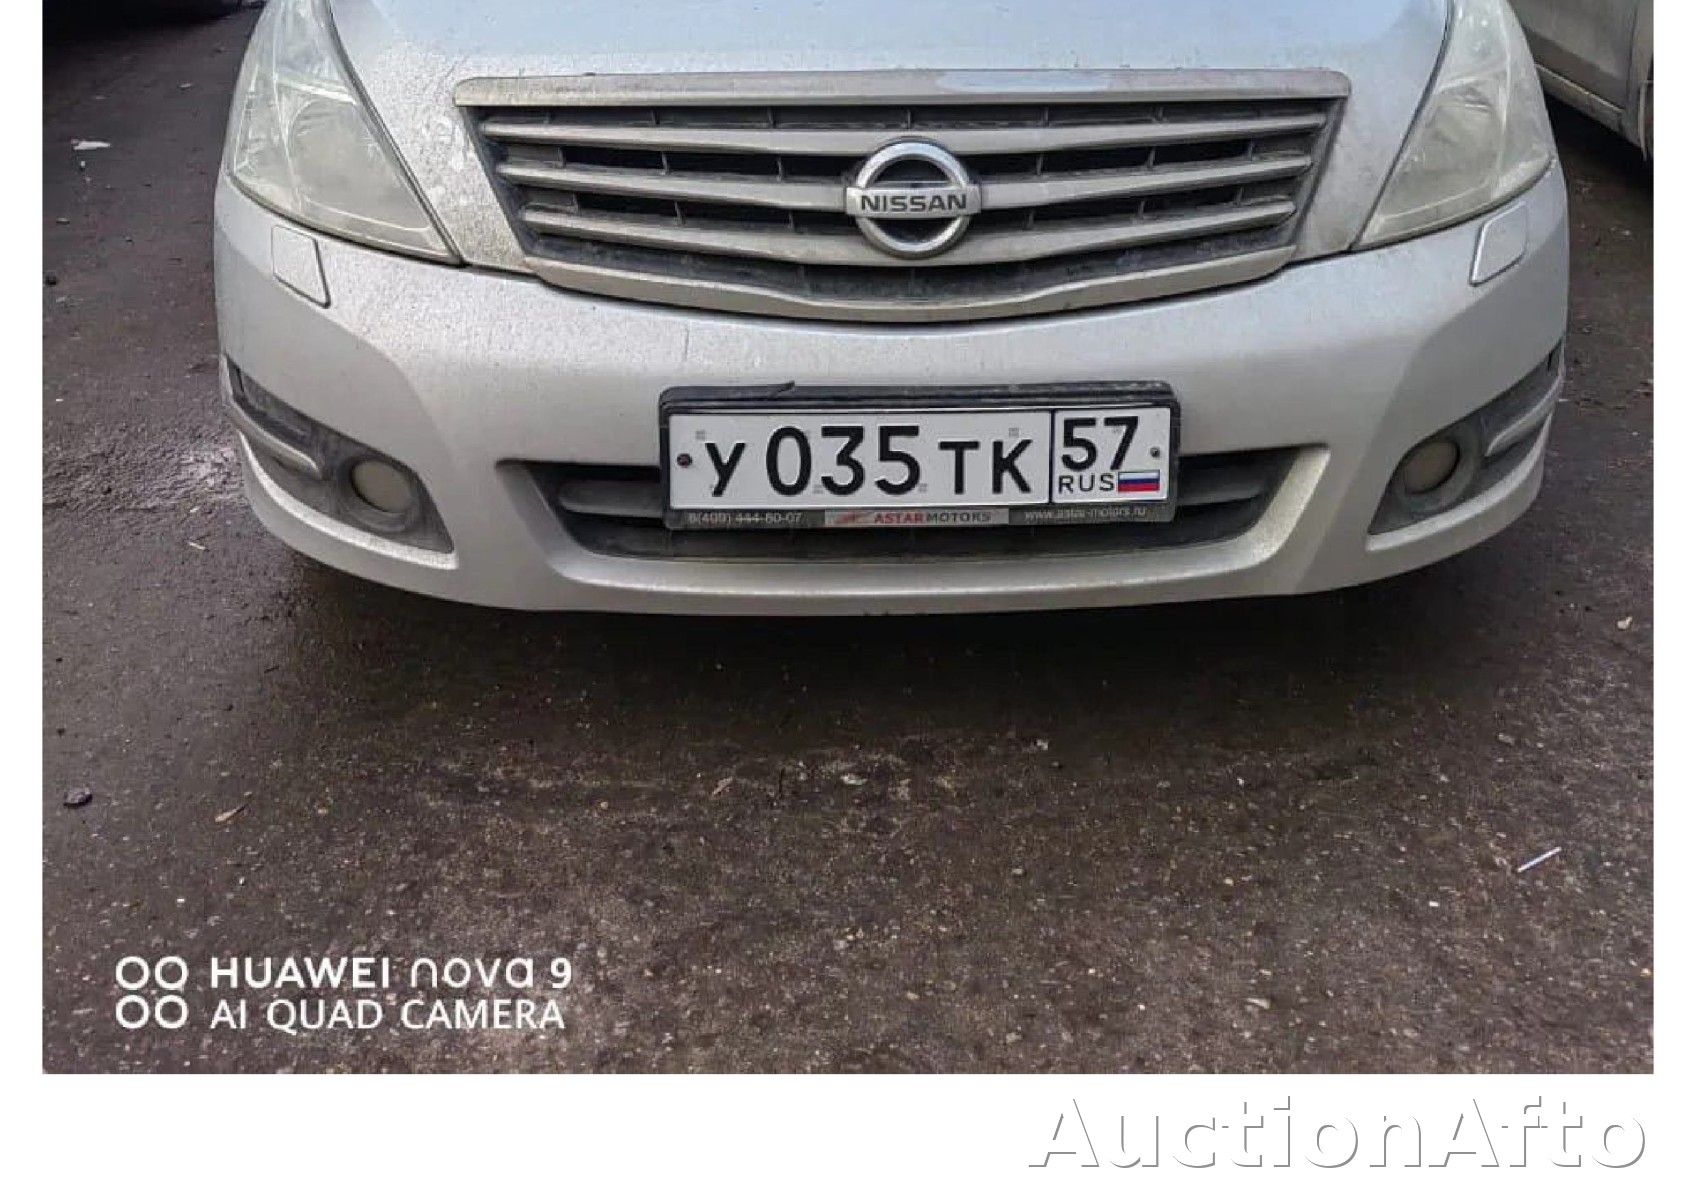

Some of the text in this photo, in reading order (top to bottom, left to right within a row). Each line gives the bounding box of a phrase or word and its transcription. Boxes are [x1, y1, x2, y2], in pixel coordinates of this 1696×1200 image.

[861, 194, 967, 212] NISSAN
[1061, 416, 1139, 472] 57
[1058, 472, 1115, 494] RUS
